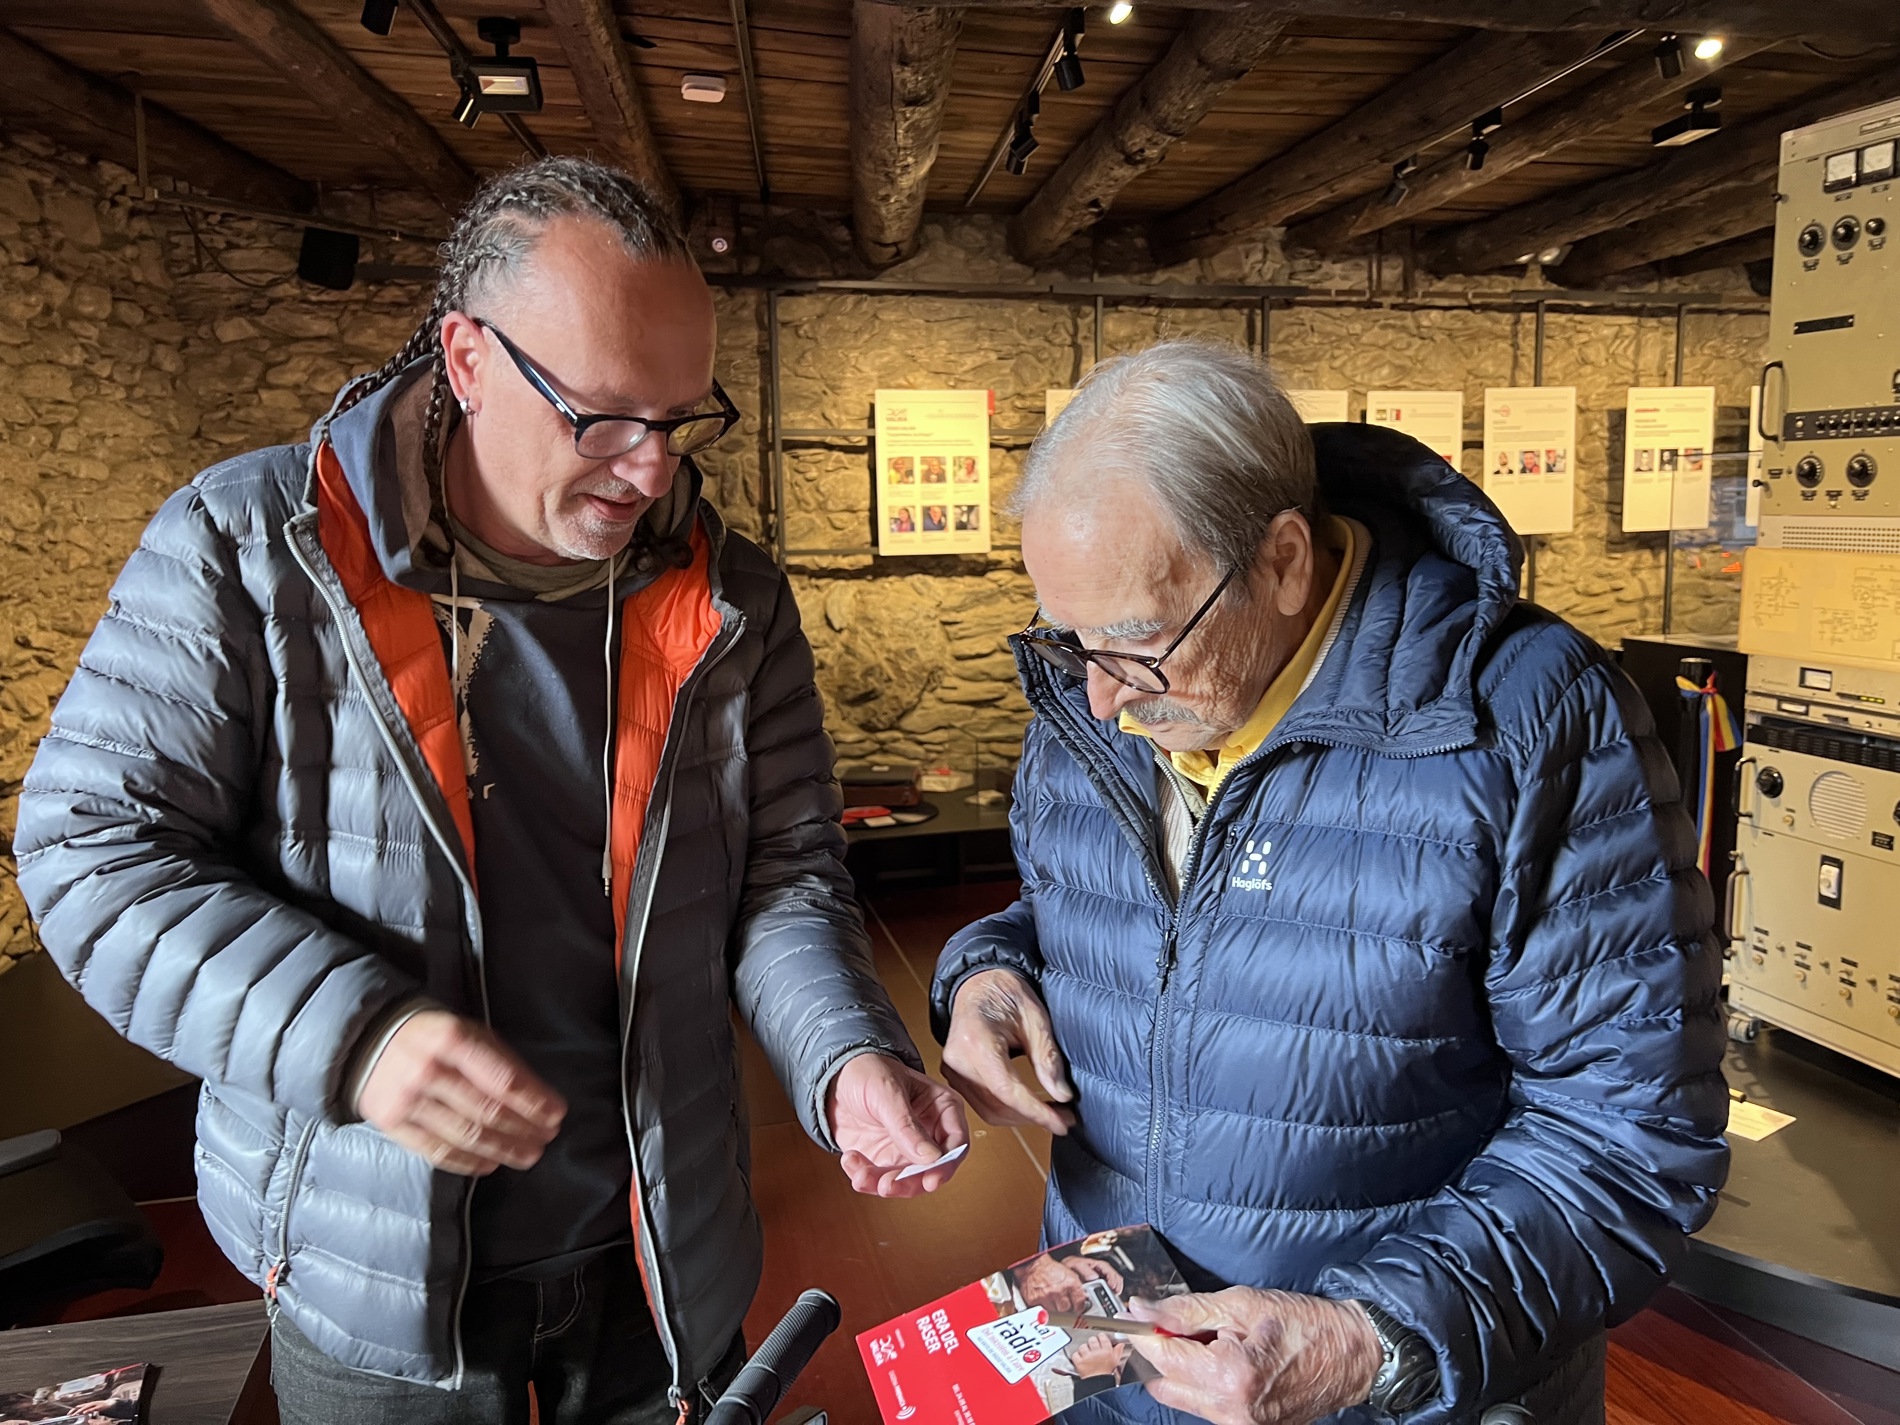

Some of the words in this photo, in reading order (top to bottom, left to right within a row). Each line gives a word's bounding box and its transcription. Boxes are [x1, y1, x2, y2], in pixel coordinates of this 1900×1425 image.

[916, 1314, 942, 1355] RASER
[931, 1308, 951, 1334] ERA
[940, 1329, 960, 1356] DEL
